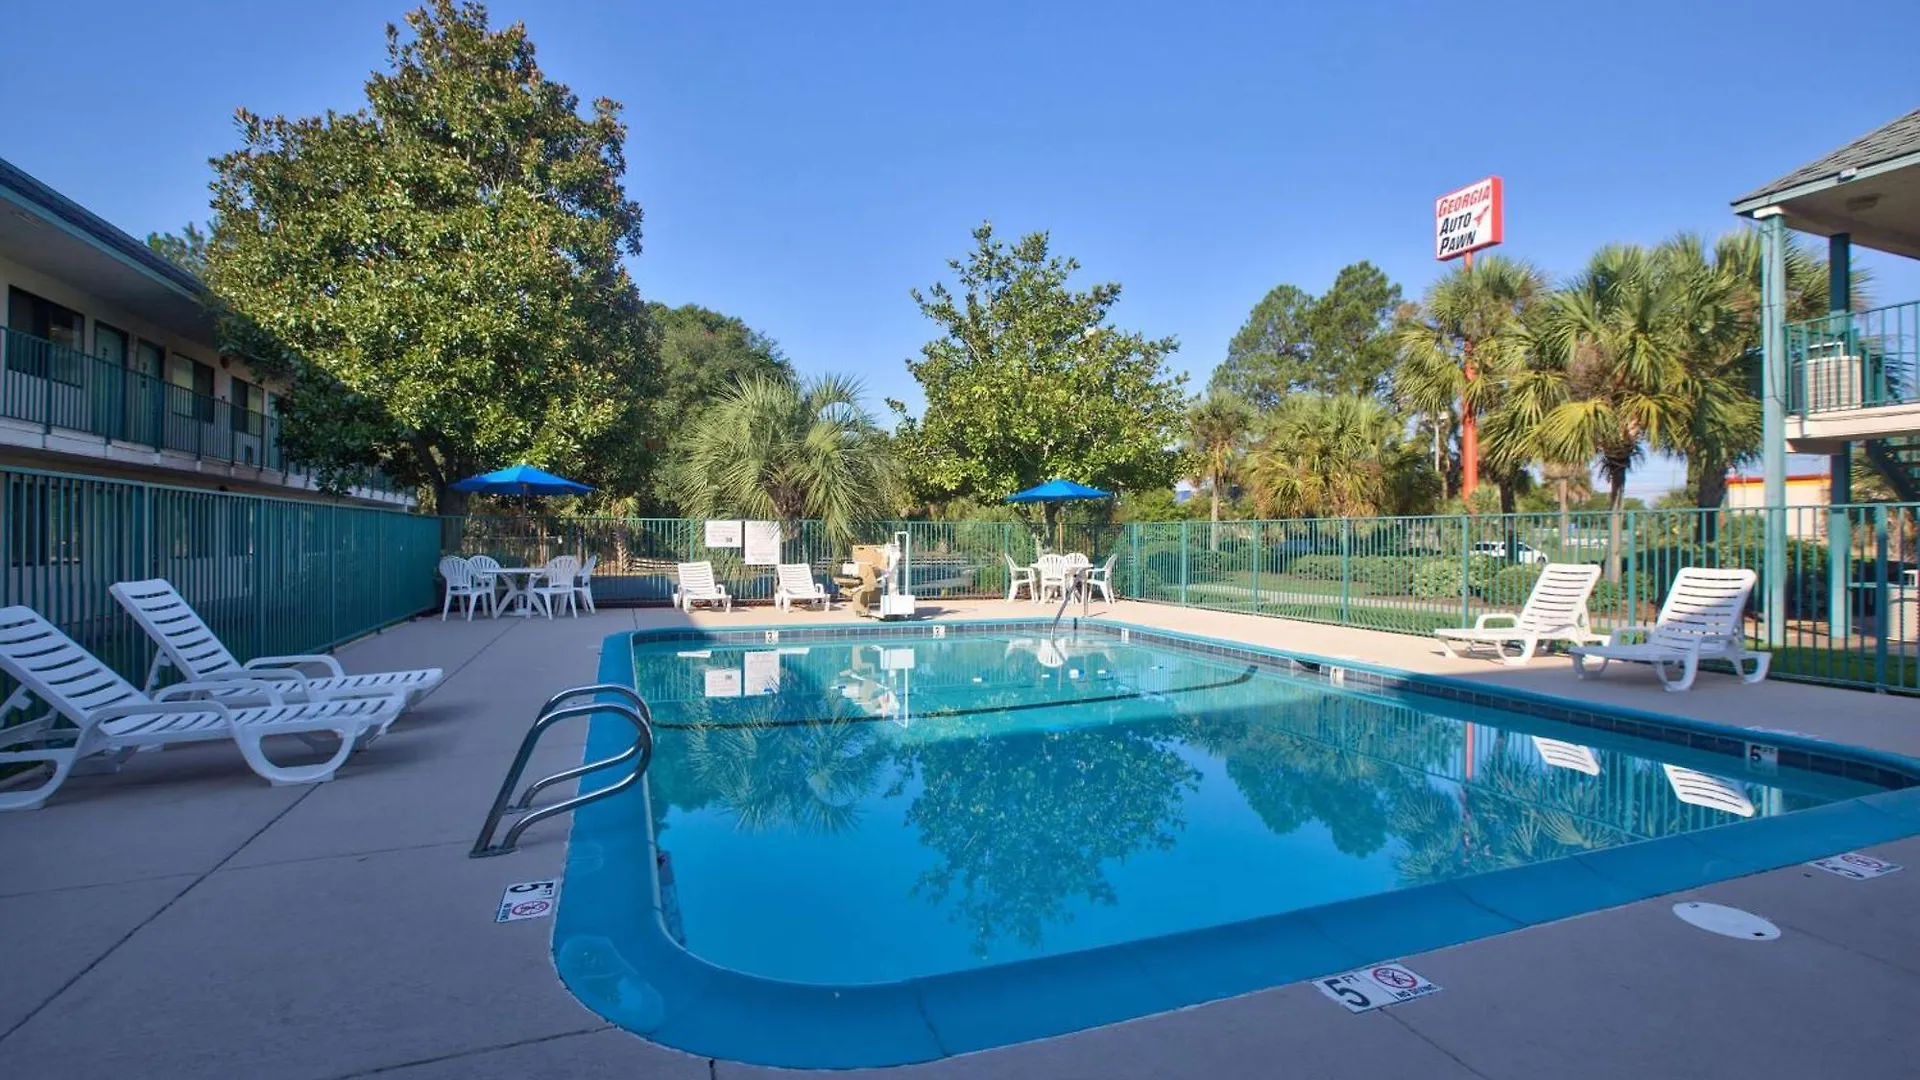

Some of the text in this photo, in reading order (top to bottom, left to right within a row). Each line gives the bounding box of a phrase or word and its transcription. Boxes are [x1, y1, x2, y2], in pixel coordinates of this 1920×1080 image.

[1438, 185, 1491, 217] GEORGIA
[1439, 211, 1472, 236] AUTO
[1439, 230, 1477, 256] PAWN
[1750, 745, 1761, 763] 5
[509, 882, 554, 893] 5
[1323, 974, 1370, 1007] 5 FT
